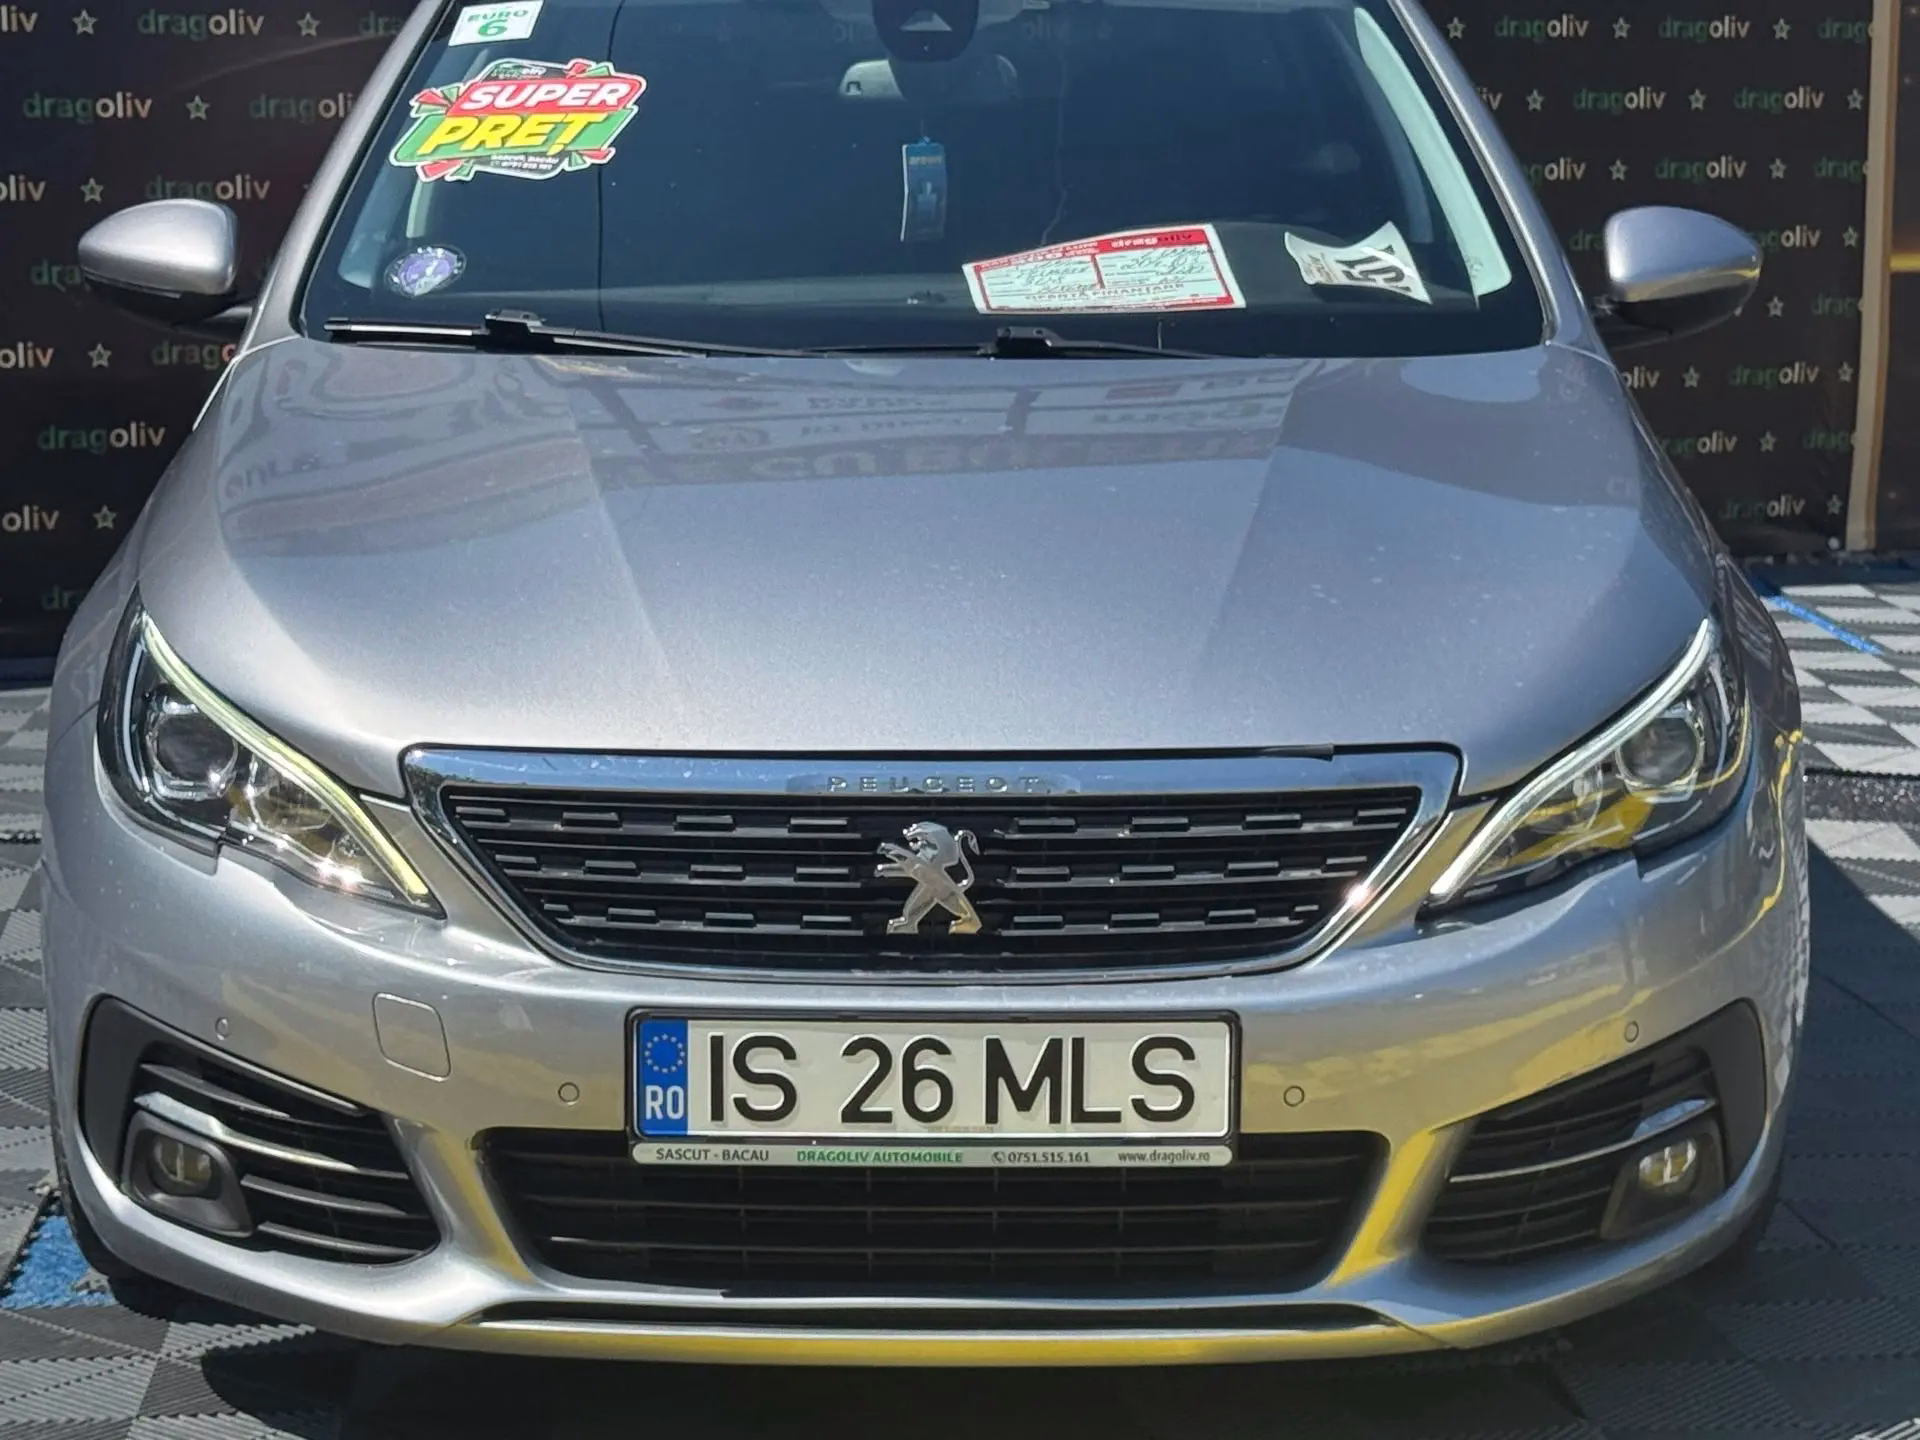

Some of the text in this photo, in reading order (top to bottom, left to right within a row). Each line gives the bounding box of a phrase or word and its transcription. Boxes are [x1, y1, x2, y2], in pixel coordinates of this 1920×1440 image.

[138, 8, 264, 41] dragoliv
[467, 10, 529, 23] EURO
[477, 19, 508, 37] 6
[1495, 13, 1589, 43] dragoliv
[1659, 15, 1751, 42] dragoliv
[1818, 17, 1873, 44] drag
[23, 91, 152, 124] dragoliv
[251, 92, 354, 124] dragoli
[461, 83, 631, 110] SUPER
[1573, 86, 1667, 114] dragoliv
[1733, 86, 1824, 114] dragoliv
[1655, 155, 1747, 184] dragoliv
[1814, 156, 1868, 183] drag
[0, 341, 54, 369] oliv
[1620, 365, 1660, 390] oliv
[1729, 361, 1820, 391] dragoliv
[37, 421, 166, 454] dragoliv
[2, 504, 60, 532] oliv
[1718, 494, 1806, 524] dragoliv
[827, 776, 1039, 792] PEUGEOT
[708, 1034, 1196, 1125] IS 26 MLS
[644, 1085, 686, 1120] RO
[656, 1148, 709, 1161] SASCUT
[722, 1149, 769, 1162] BACAU
[797, 1150, 963, 1164] DRAGOLIV AUTOMOBILE
[1008, 1151, 1090, 1164] 0751.515.161
[1118, 1150, 1211, 1165] www.dragoliv.ro
